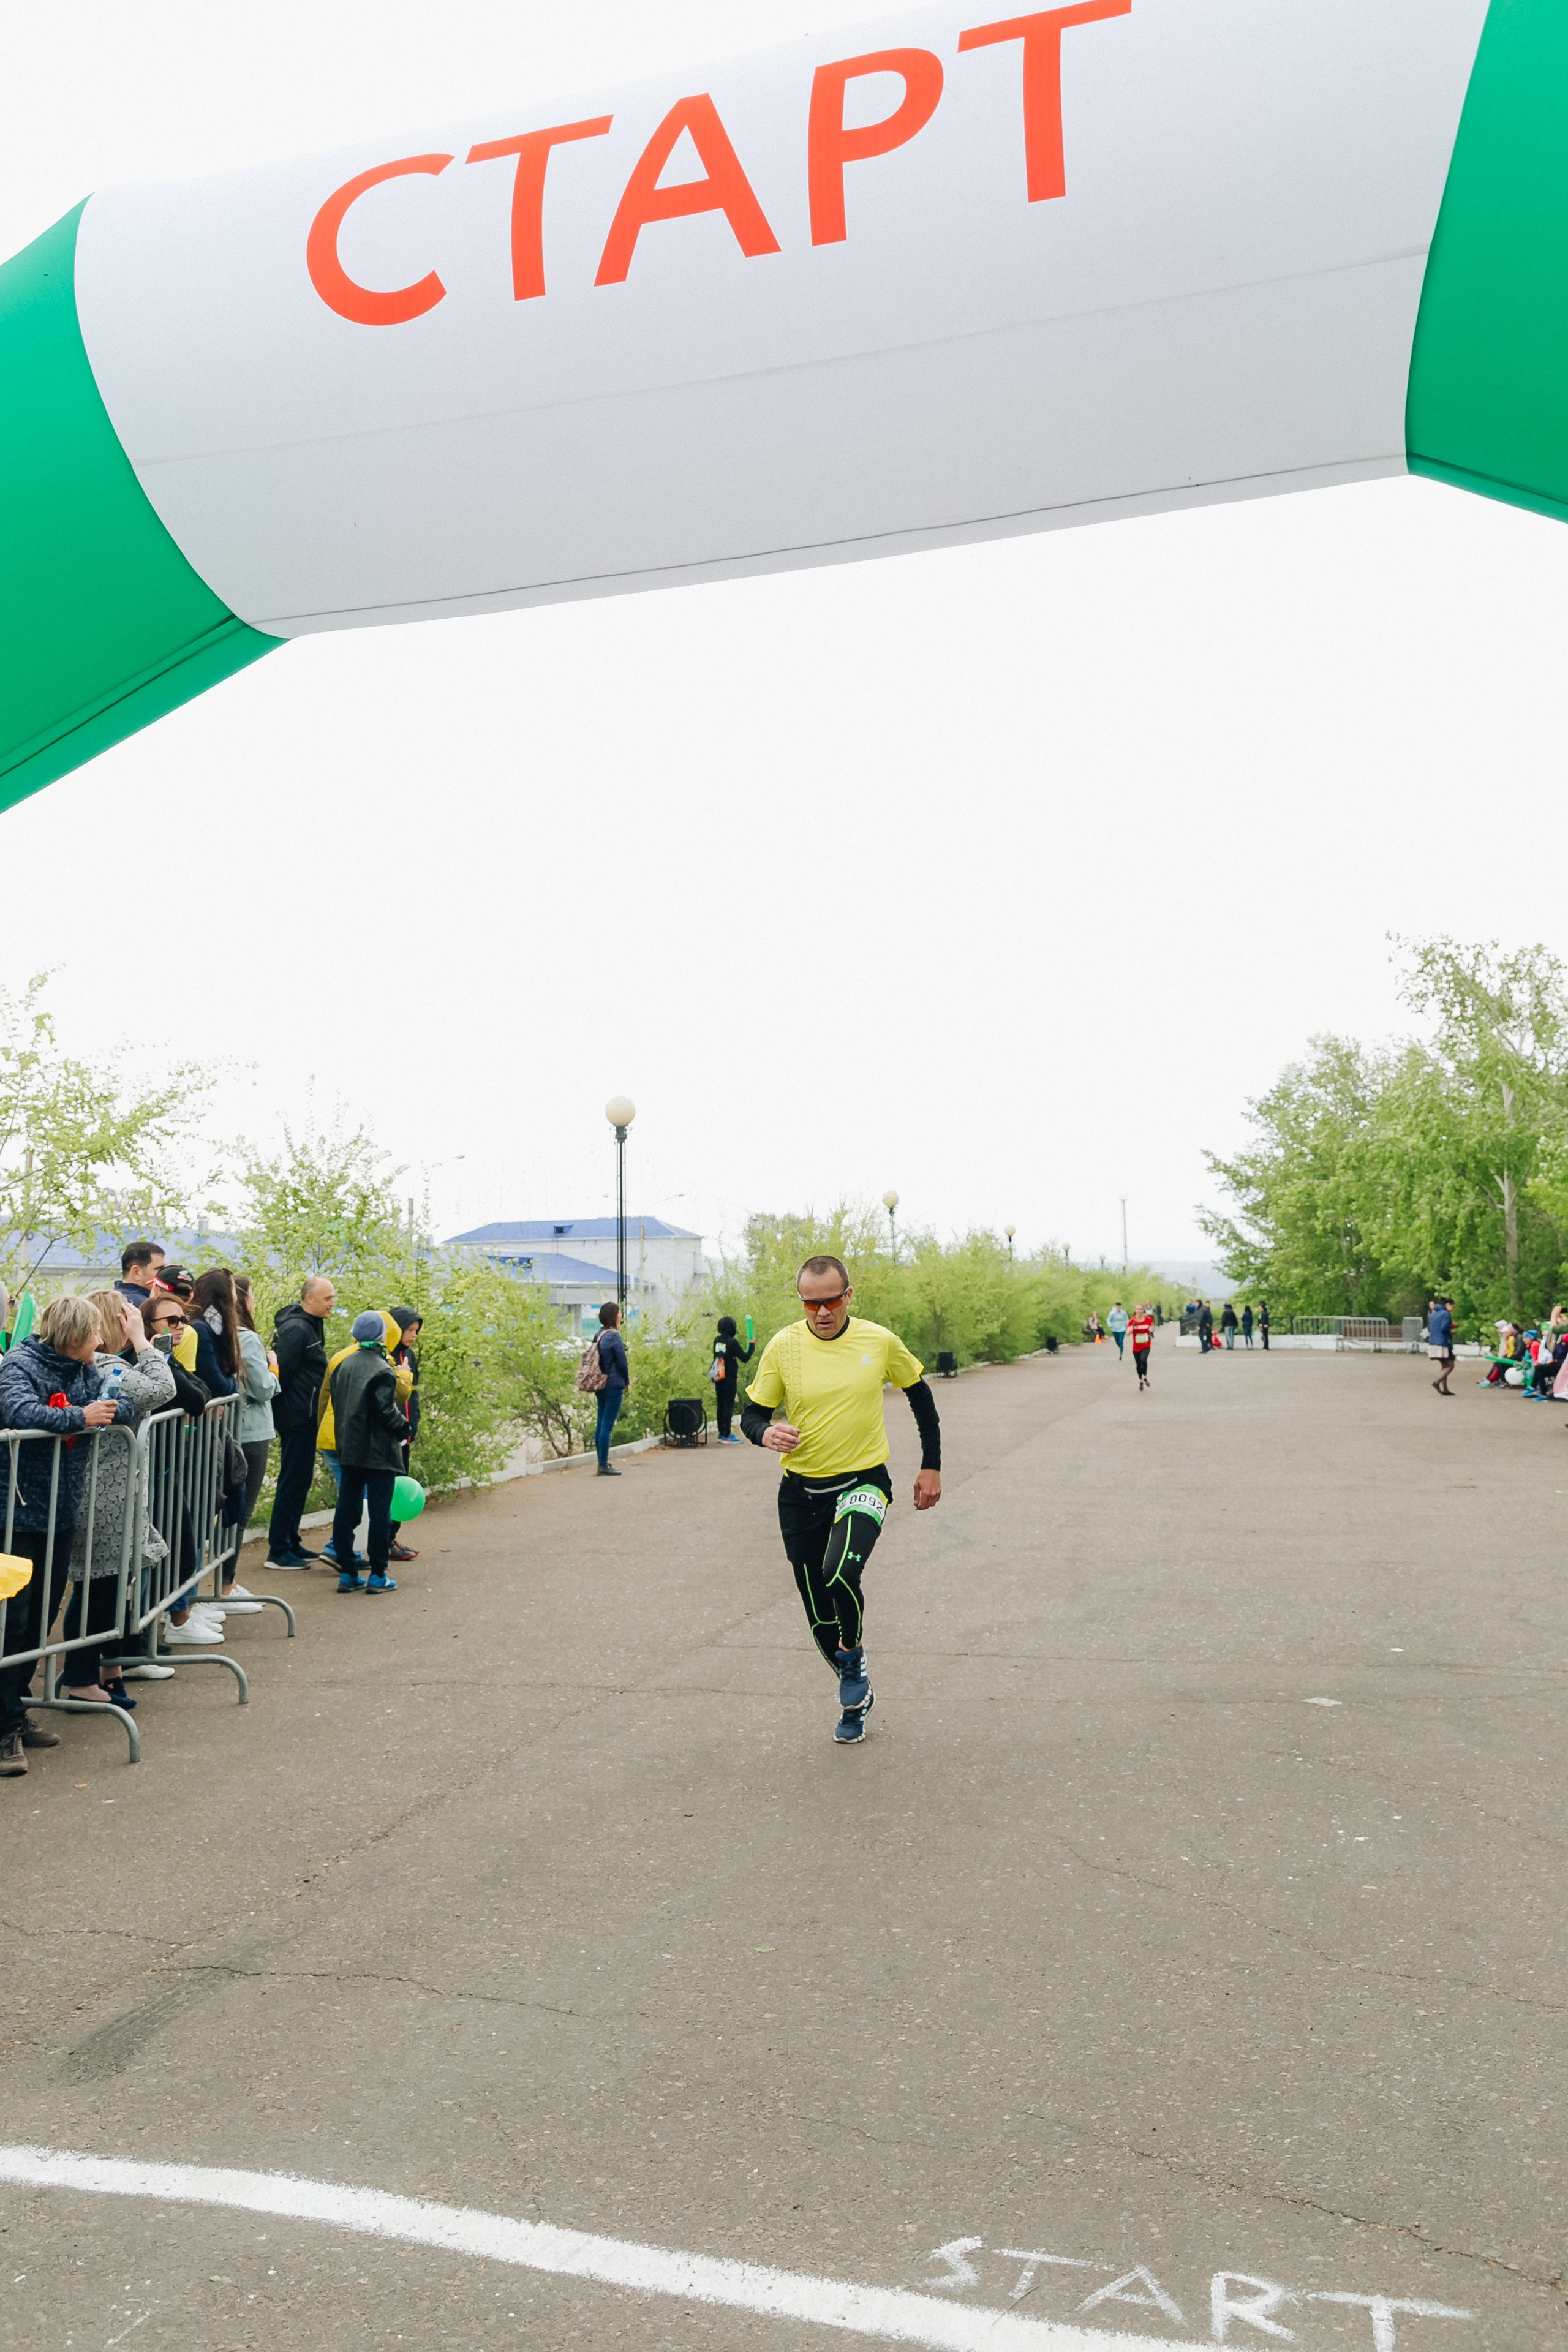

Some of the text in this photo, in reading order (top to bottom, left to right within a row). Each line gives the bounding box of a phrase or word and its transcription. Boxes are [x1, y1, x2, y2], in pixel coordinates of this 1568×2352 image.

[306, 0, 1132, 326] СТАРТ
[850, 1493, 883, 1515] 0092
[922, 2236, 1479, 2352] START
